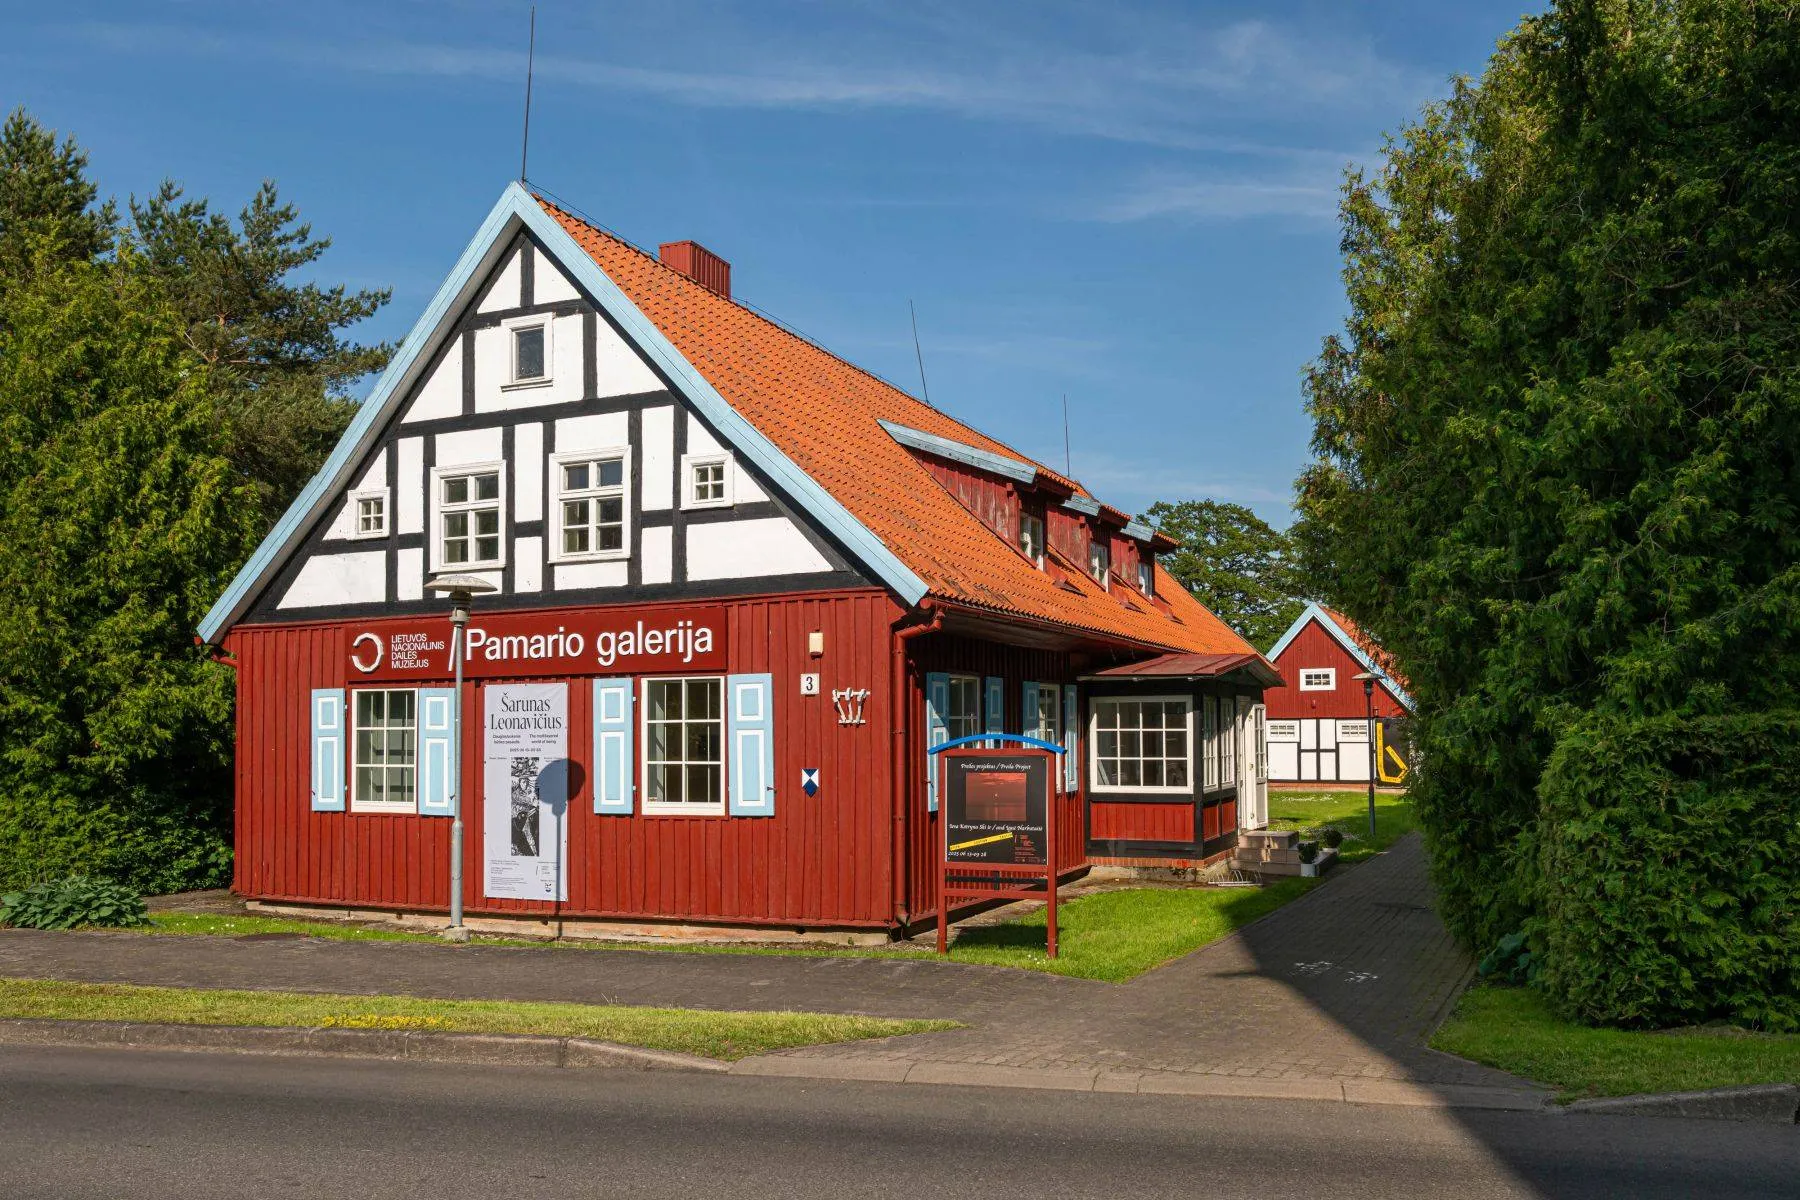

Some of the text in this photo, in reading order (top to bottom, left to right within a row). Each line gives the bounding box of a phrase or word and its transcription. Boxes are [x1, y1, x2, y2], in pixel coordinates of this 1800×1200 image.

[391, 633, 427, 643] LIETUVOS
[466, 626, 585, 661] Pamario
[596, 620, 713, 667] galerija
[391, 641, 445, 651] NACIONALINIS
[391, 659, 429, 669] MUZIEJUS
[806, 676, 813, 691] 3
[490, 713, 562, 730] Leonavičius
